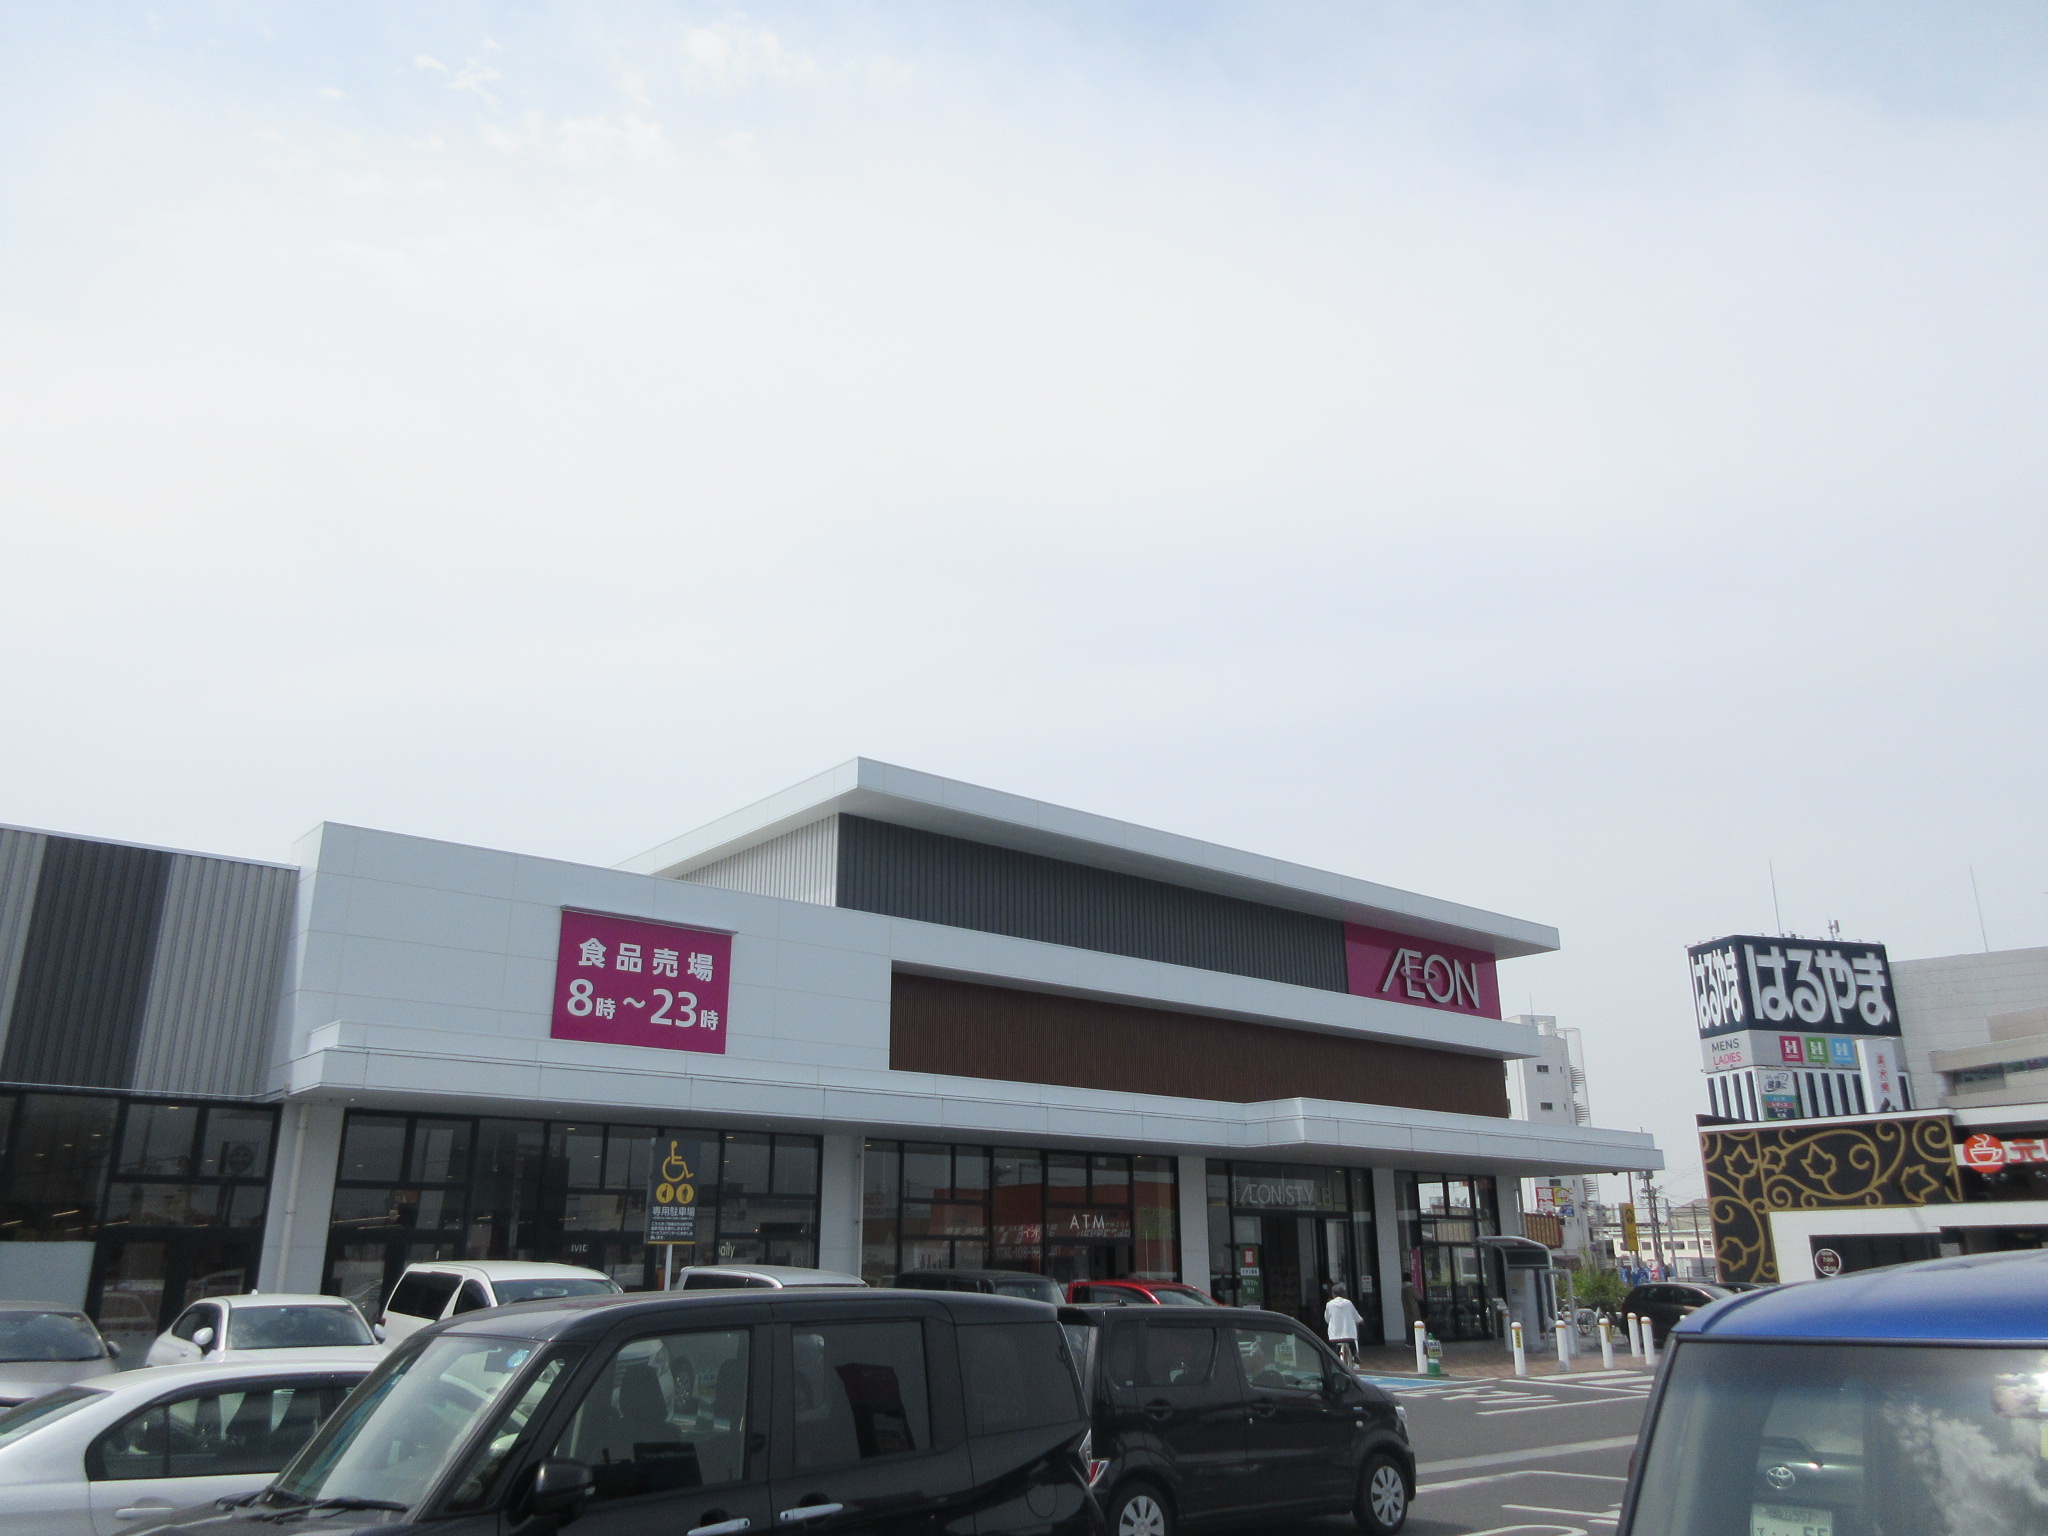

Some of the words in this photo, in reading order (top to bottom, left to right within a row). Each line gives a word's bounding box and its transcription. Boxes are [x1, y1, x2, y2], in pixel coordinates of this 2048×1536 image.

[578, 937, 713, 982] 食品売場
[1691, 946, 1743, 1029] はるやま
[1743, 944, 1892, 1026] はるやま
[1711, 1038, 1740, 1053] MENS
[1713, 1051, 1742, 1066] LADIES
[2009, 1138, 2048, 1164] 元
[652, 1206, 695, 1217] 専用駐車場
[1069, 1214, 1105, 1230] ATM
[718, 1241, 736, 1259] aily
